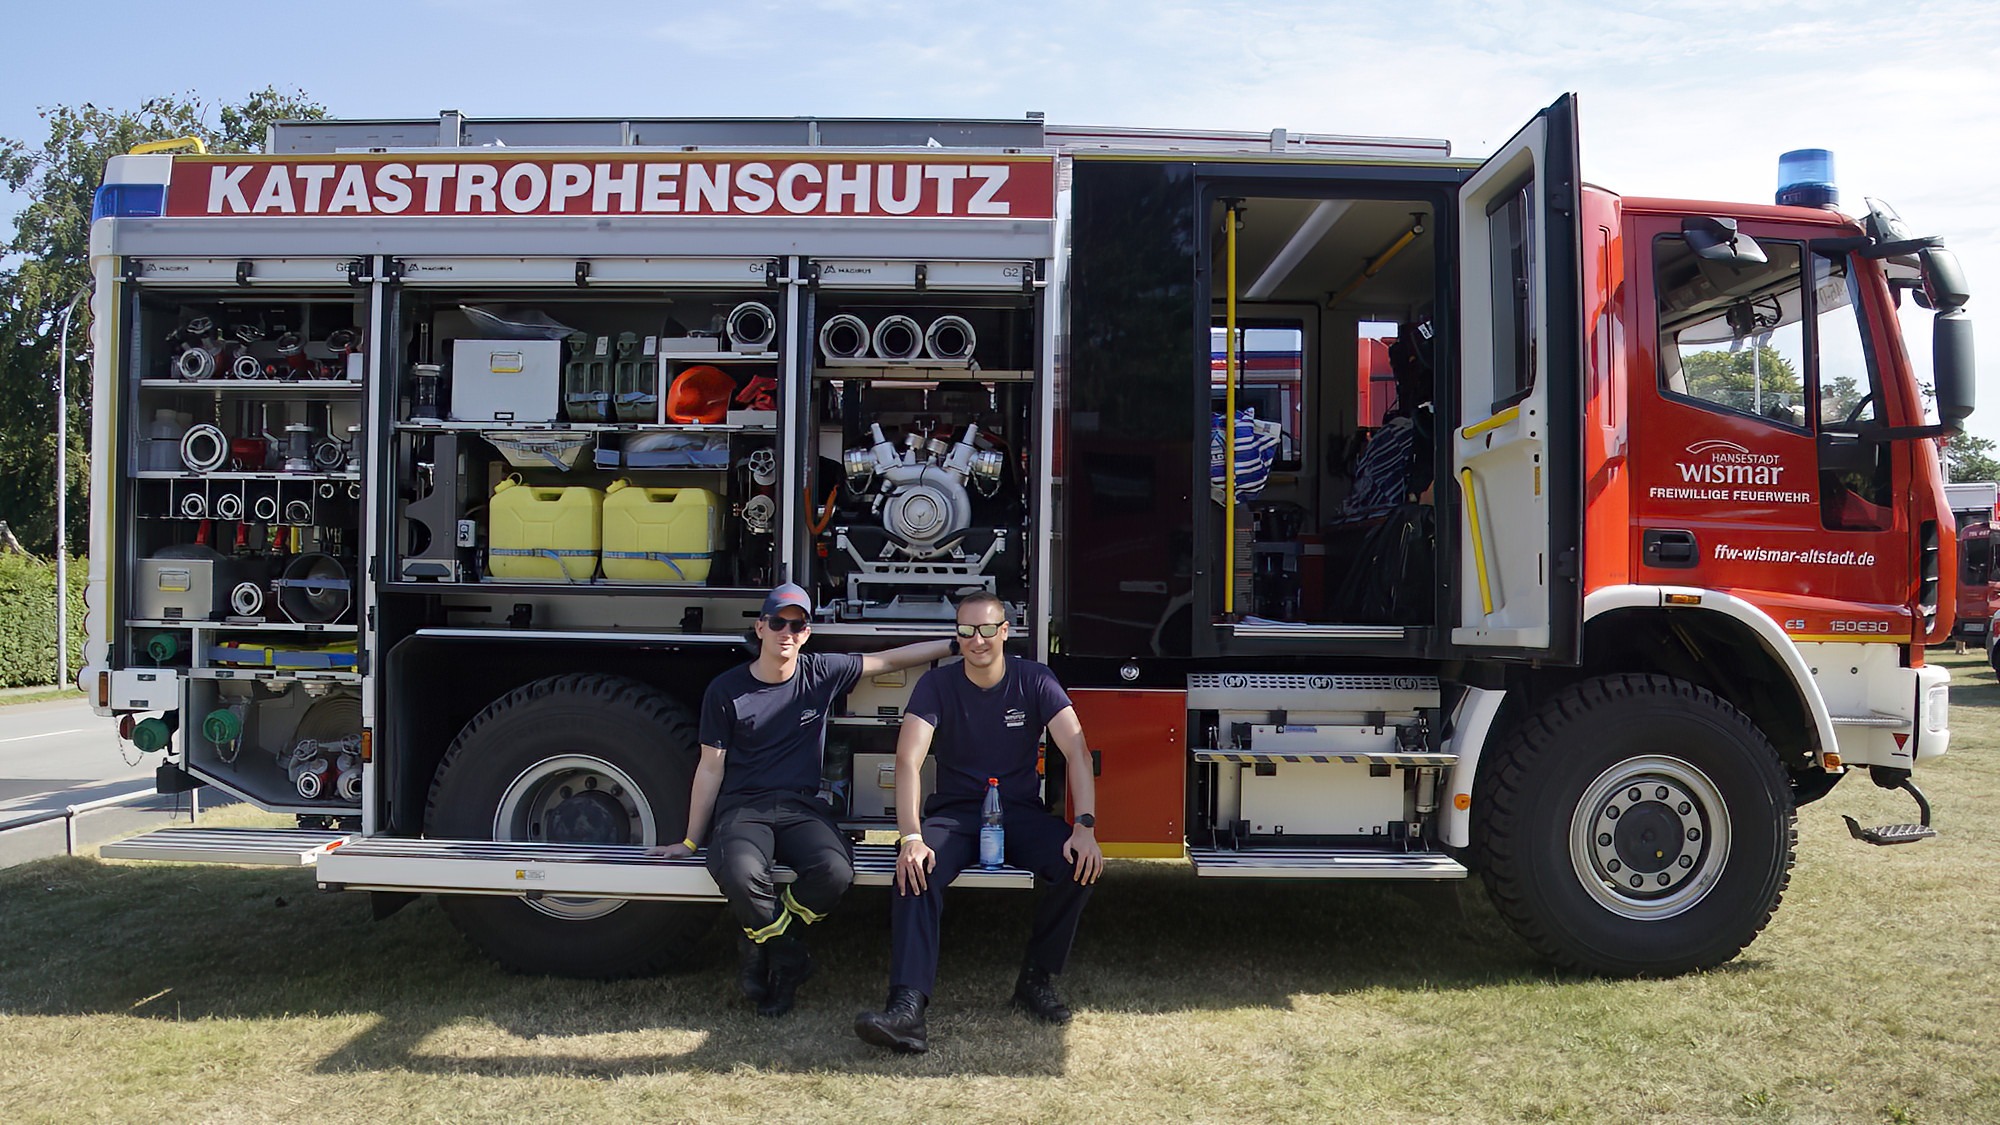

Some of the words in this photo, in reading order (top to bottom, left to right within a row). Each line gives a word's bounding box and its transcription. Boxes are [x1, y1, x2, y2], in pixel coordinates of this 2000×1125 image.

[207, 162, 1010, 214] KATASTROPHENSCHUTZ
[749, 263, 764, 273] G4
[1003, 267, 1019, 278] G2
[1712, 452, 1780, 465] HANSESTADT
[1650, 487, 1729, 501] FREIWILLIGE
[1733, 490, 1811, 503] FEUERWEHR
[1714, 544, 1876, 566] ffw-wismar-altstadt.de
[1785, 619, 1805, 630] E5
[1830, 620, 1889, 633] 150E30
